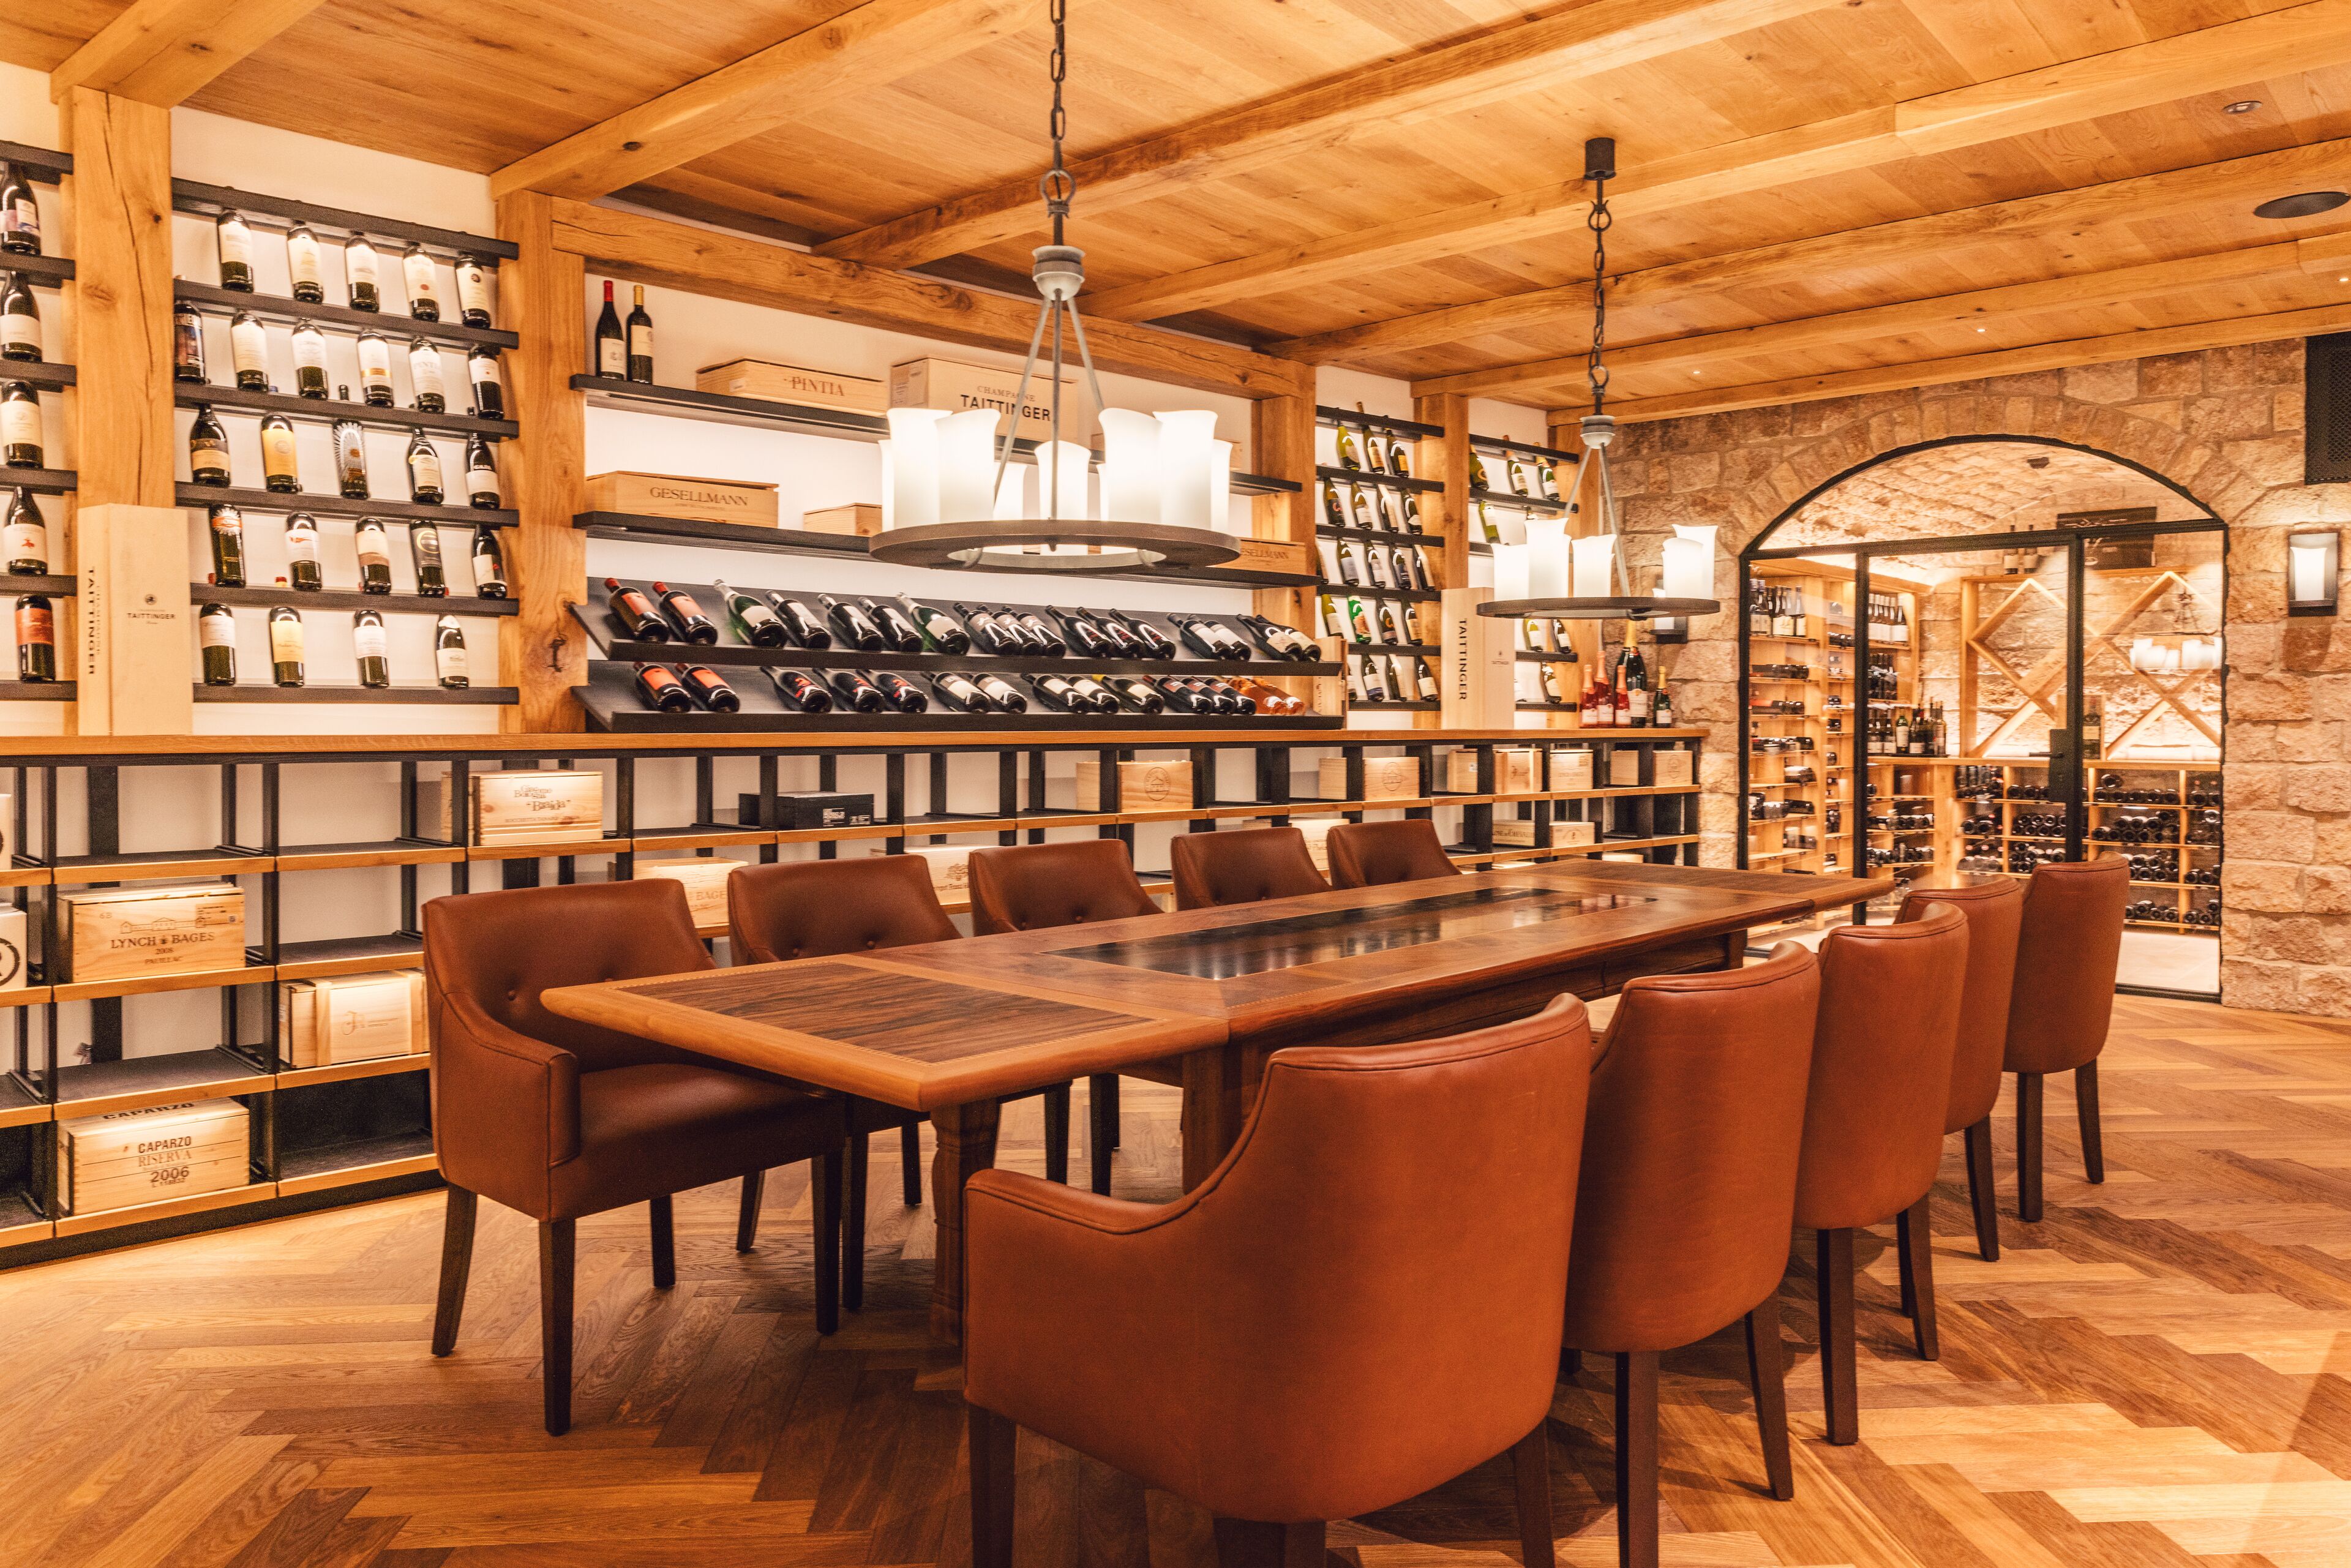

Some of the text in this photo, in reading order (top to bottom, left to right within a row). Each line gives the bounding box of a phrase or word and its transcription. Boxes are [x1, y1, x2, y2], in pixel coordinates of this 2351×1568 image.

[789, 376, 845, 396] PINTIA
[977, 386, 1036, 402] CHAMPANE
[650, 487, 748, 506] GESELLMANN
[1458, 618, 1468, 700] TAITTINGER
[696, 890, 726, 901] BAGE
[111, 932, 216, 948] LYNCH BAGES
[102, 1103, 195, 1120] CAPARZO
[138, 1136, 192, 1153] CAPARZO
[138, 1150, 192, 1167] RISERVA
[150, 1166, 190, 1183] 2006
